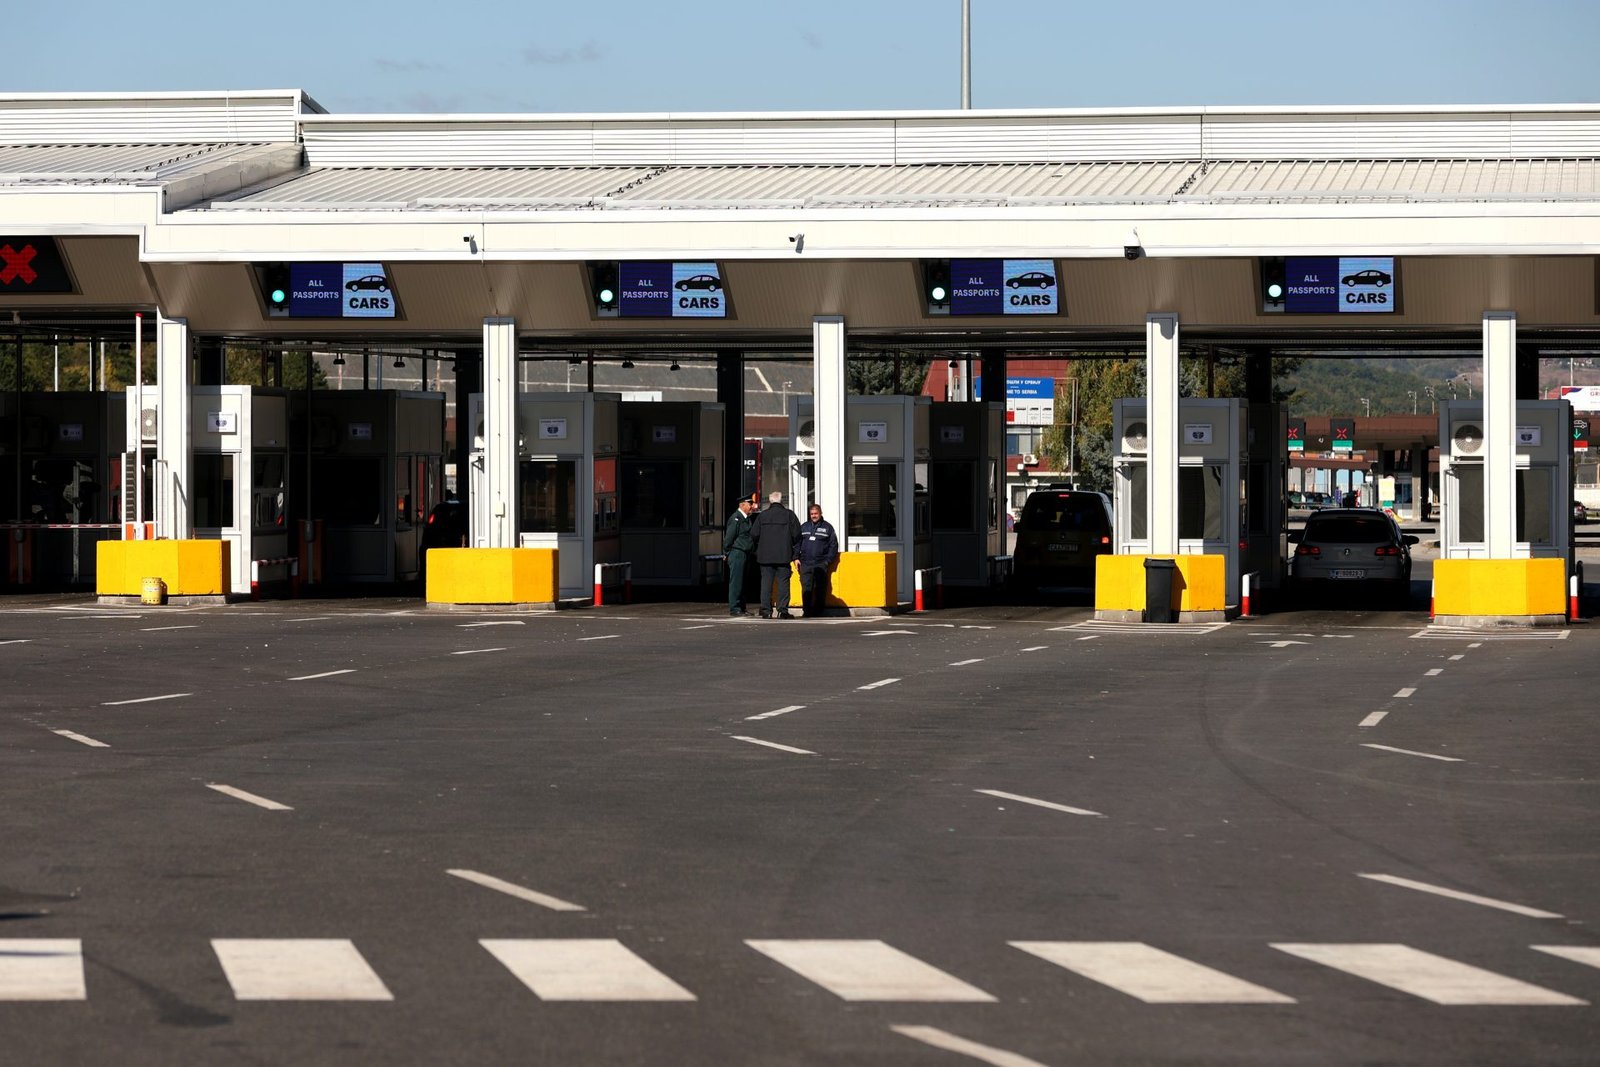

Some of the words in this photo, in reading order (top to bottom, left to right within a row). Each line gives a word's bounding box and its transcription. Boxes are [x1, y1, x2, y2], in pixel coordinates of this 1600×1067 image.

[349, 298, 389, 309] CARS
[679, 297, 719, 308] CARS
[1010, 295, 1051, 306] CARS
[1346, 293, 1388, 304] CARS
